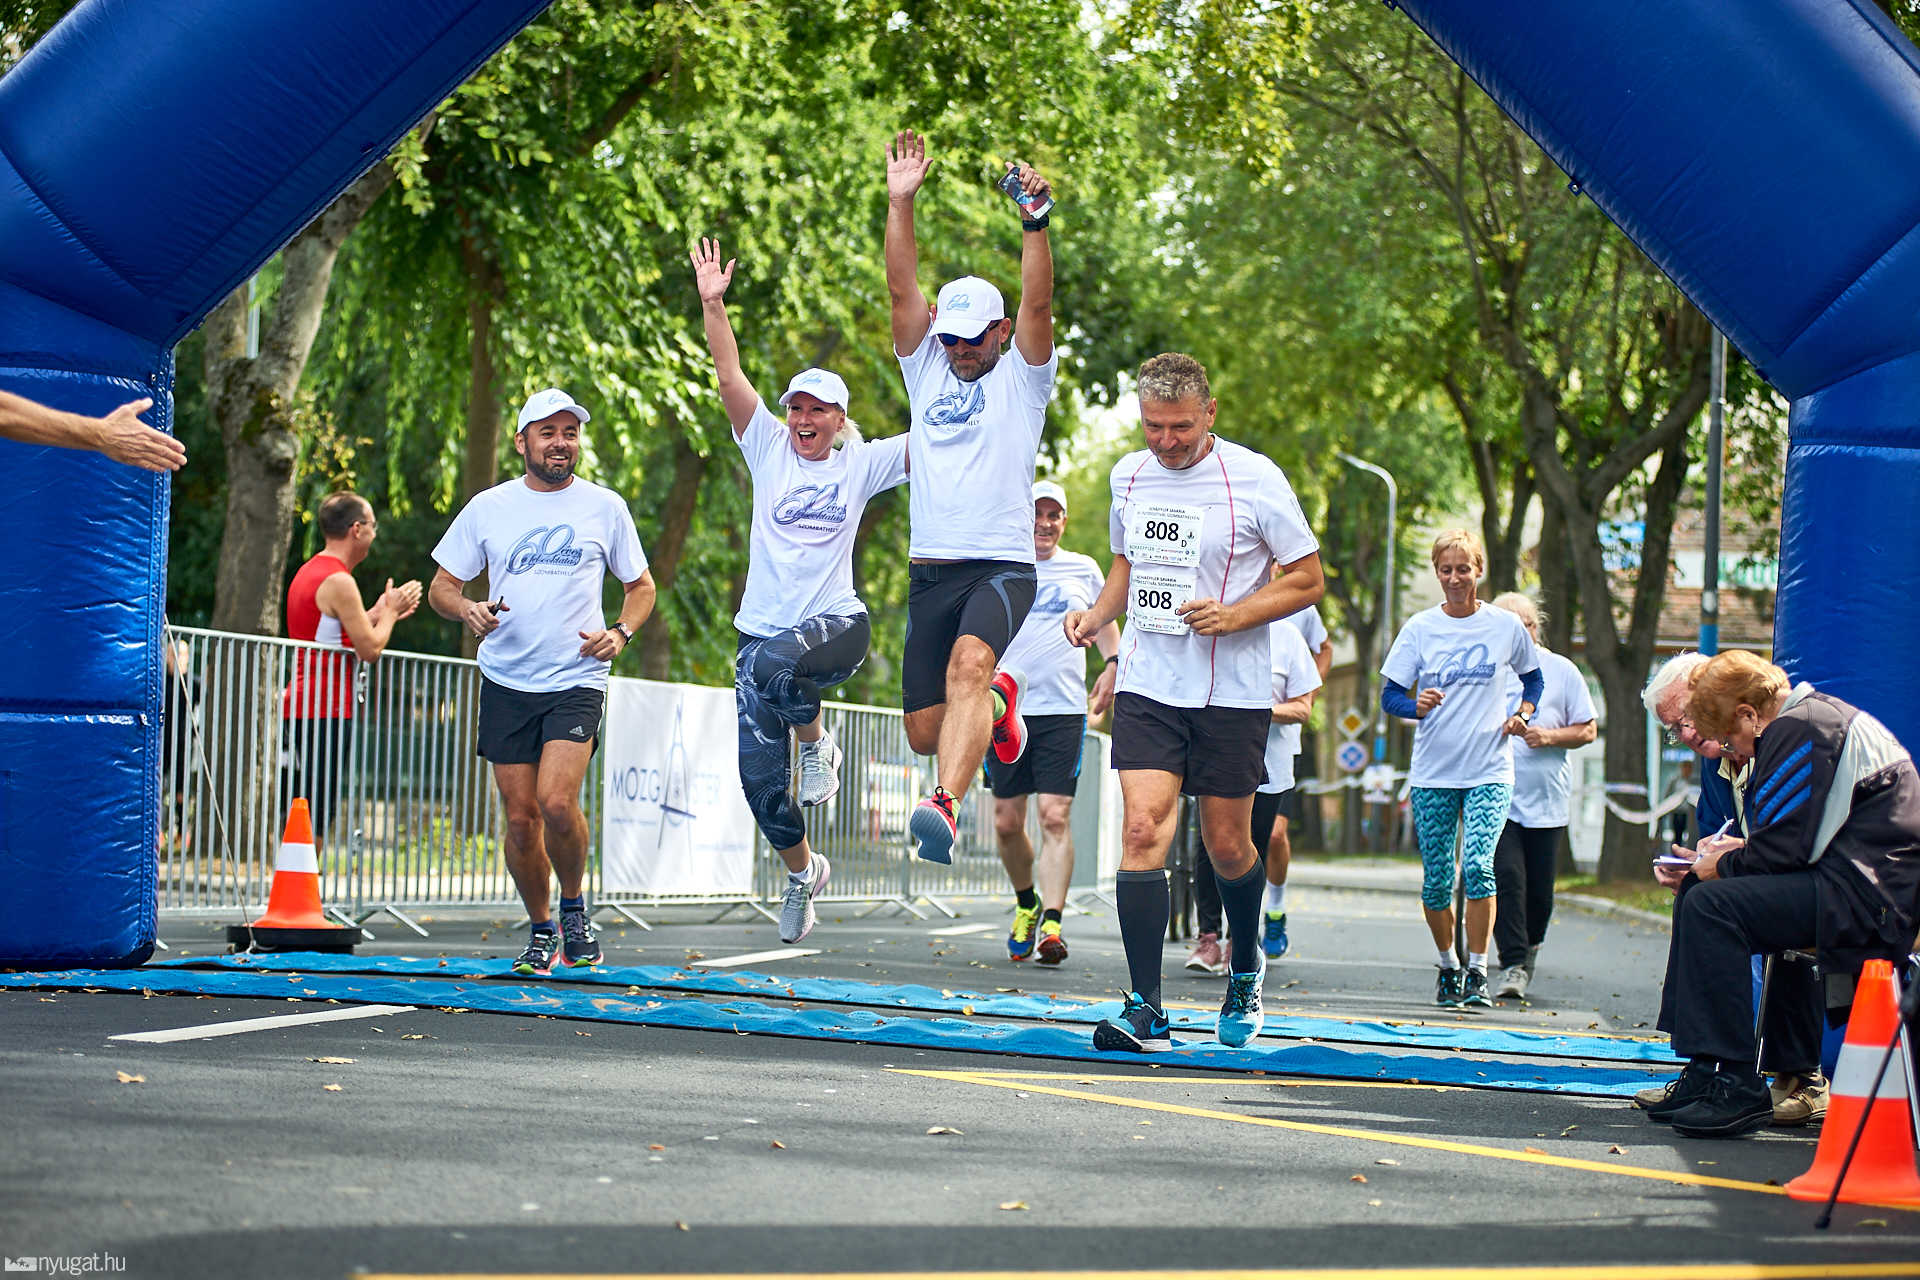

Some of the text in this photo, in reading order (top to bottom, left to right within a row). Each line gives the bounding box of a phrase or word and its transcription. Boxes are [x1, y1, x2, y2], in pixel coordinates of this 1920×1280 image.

[772, 484, 839, 525] 60
[1145, 520, 1179, 541] 808
[505, 524, 575, 575] 60
[1181, 539, 1188, 548] D
[1138, 589, 1172, 610] 808
